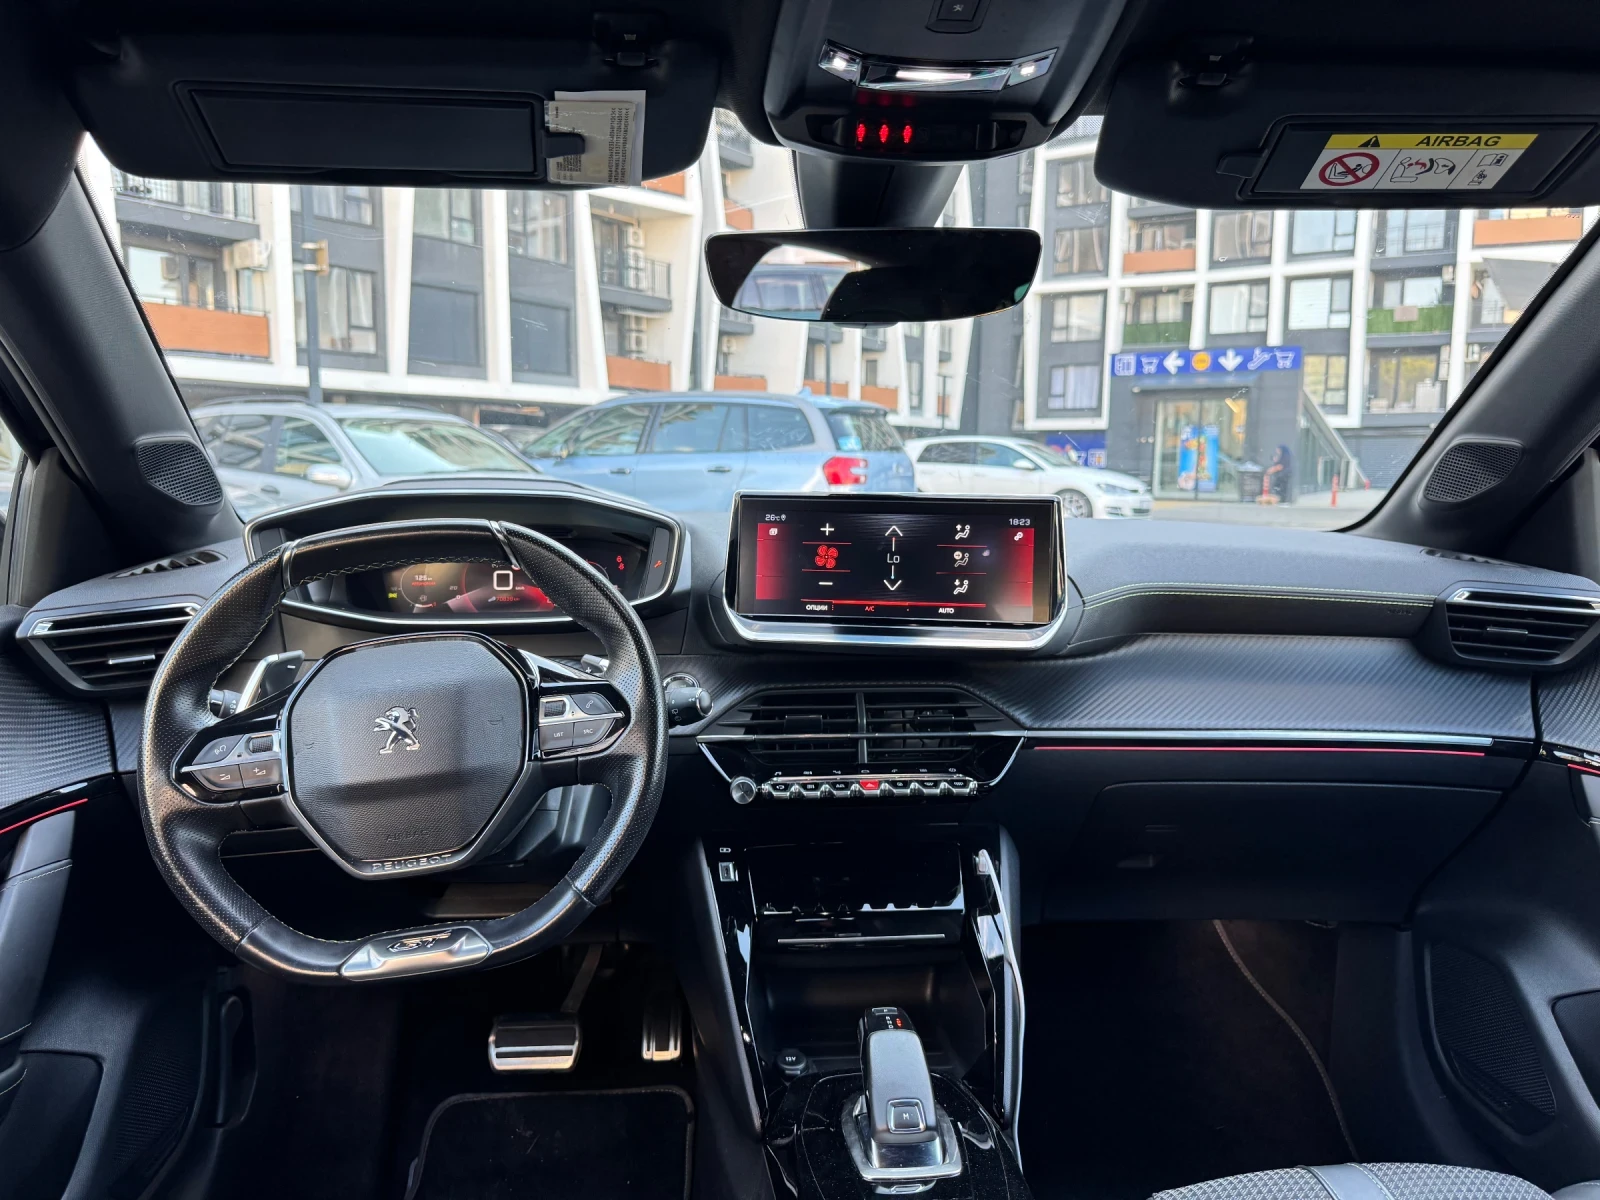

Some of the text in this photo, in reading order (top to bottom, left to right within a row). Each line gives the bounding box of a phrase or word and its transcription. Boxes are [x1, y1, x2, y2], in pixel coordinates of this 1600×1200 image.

[1415, 135, 1502, 147] AIRBAG
[493, 570, 513, 590] 0
[371, 854, 452, 872] PEUGEOT
